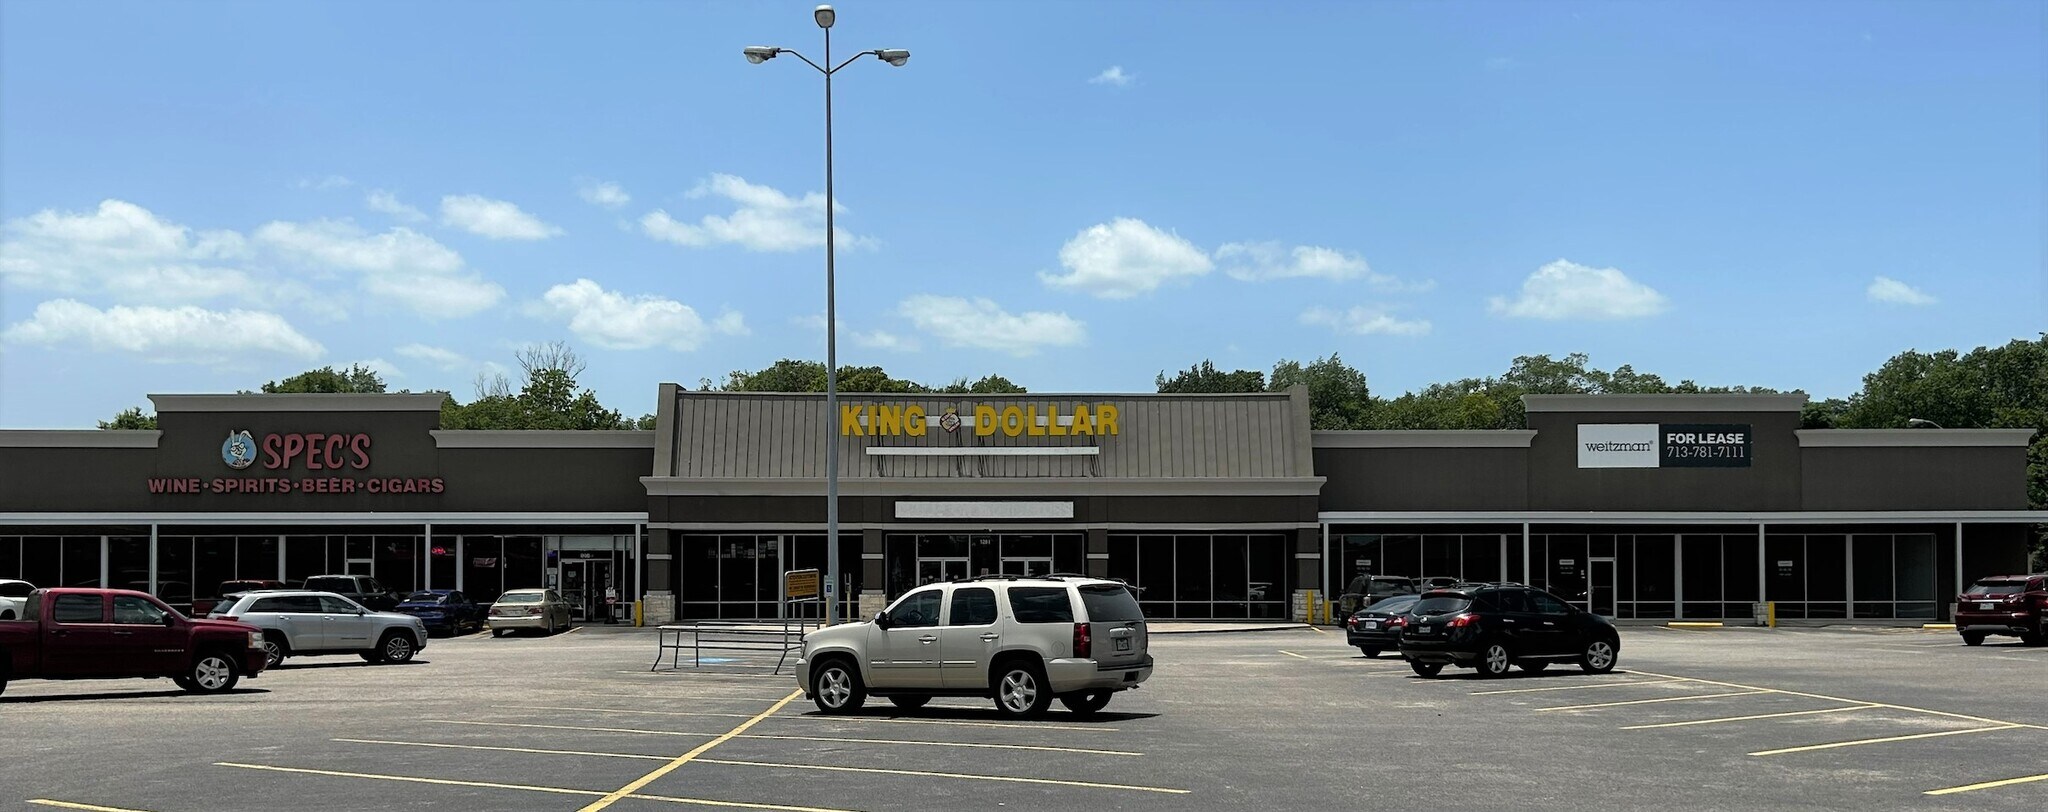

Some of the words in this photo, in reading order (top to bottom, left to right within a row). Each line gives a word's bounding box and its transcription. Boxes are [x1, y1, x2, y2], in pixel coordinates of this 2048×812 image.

[841, 405, 926, 437] KING
[975, 405, 1119, 437] DOLLAR
[1667, 433, 1696, 444] FOR
[1698, 433, 1745, 444] LEASE
[262, 433, 371, 470] SPEC'S
[1585, 441, 1651, 452] weitzman
[1667, 446, 1744, 458] 713-781-7111
[148, 478, 201, 493] WINE
[211, 478, 291, 494] SPIRITS
[302, 478, 355, 493] BEER
[367, 478, 445, 493] CIGARS
